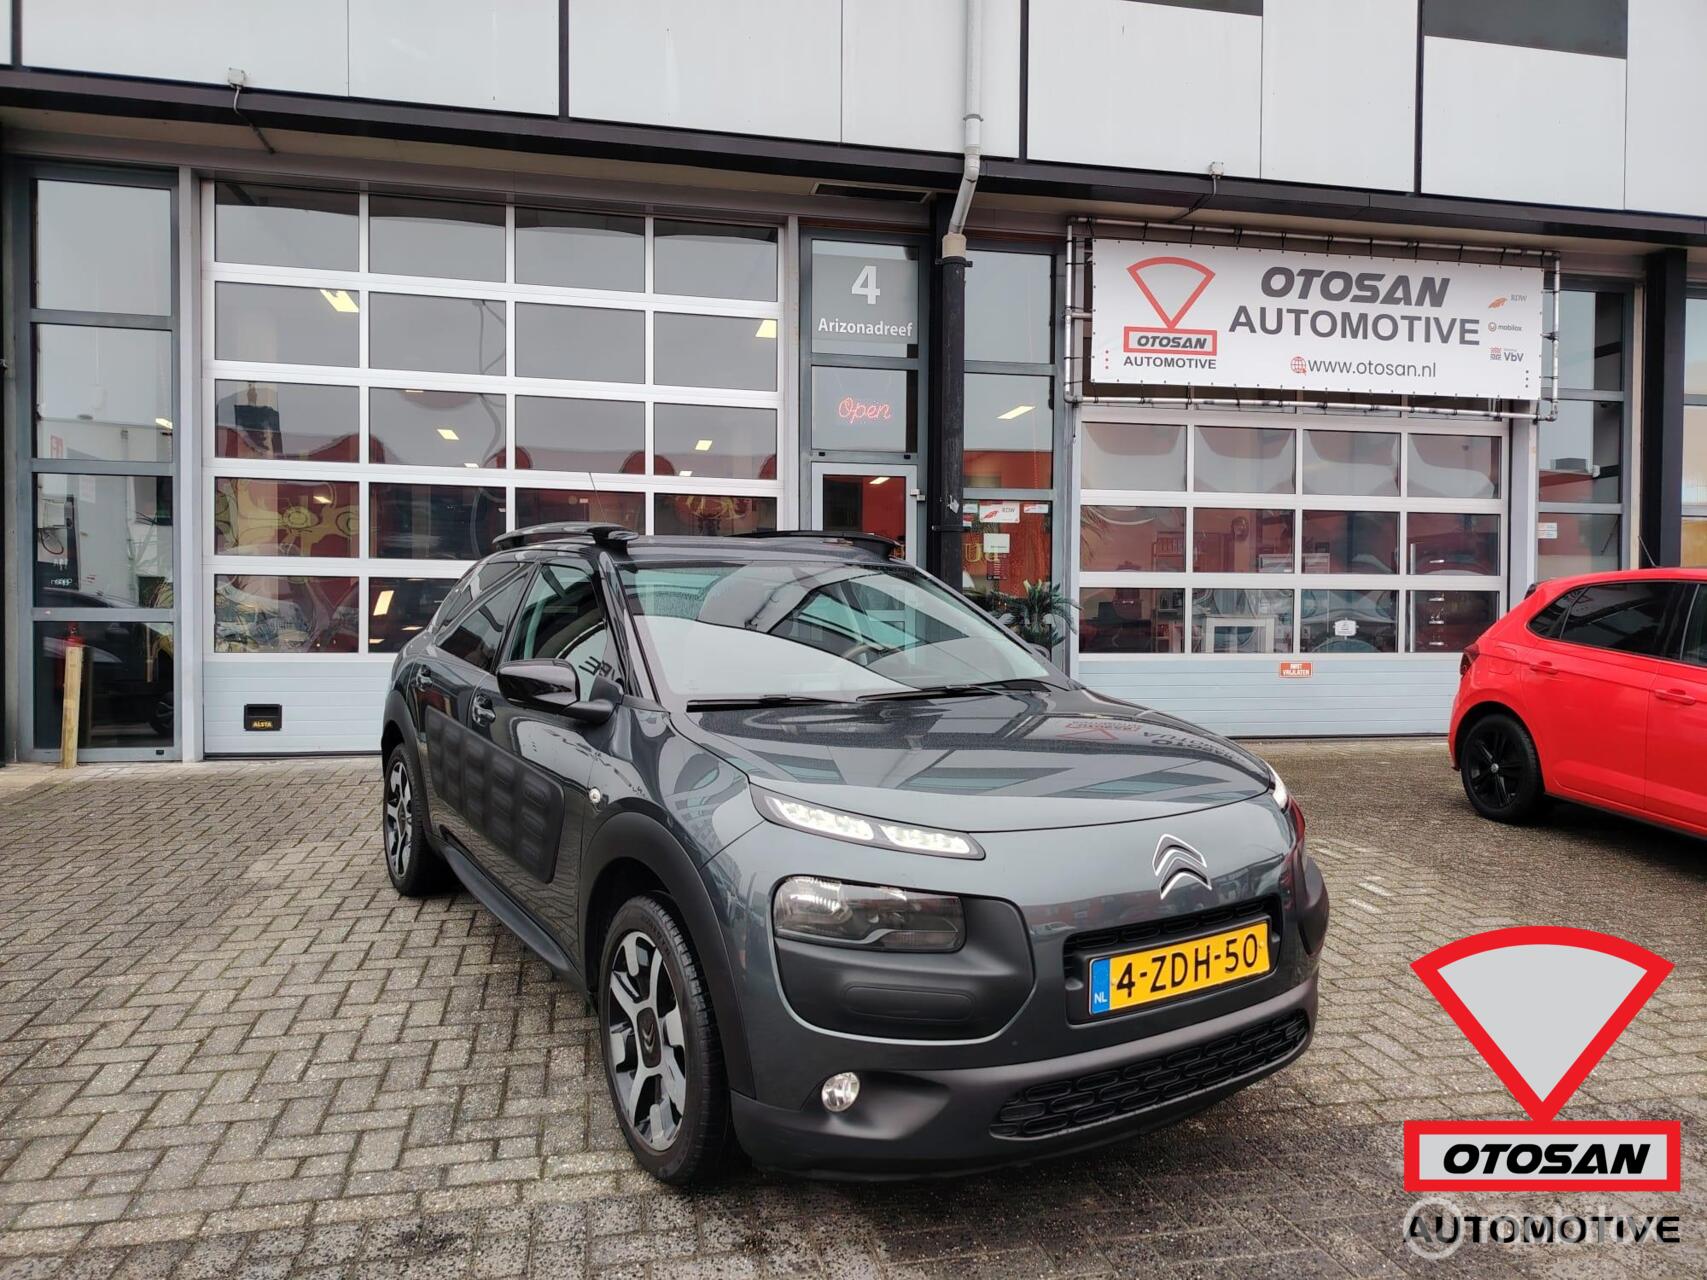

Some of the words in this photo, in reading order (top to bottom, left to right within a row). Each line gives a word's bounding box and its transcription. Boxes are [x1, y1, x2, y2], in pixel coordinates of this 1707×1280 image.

[851, 265, 881, 304] 4
[1260, 266, 1450, 308] OTOSAN
[818, 317, 912, 337] Arizonadreef
[1228, 305, 1480, 346] AUTOMOTIVE
[1136, 334, 1207, 350] OTOSAN
[1123, 355, 1217, 370] AUTOMOTIVE
[1504, 352, 1524, 361] VbV
[1308, 358, 1437, 378] www.otosan.nl
[838, 397, 892, 423] Open
[1116, 933, 1258, 998] 4-ZDH-50
[1094, 992, 1108, 1004] NL
